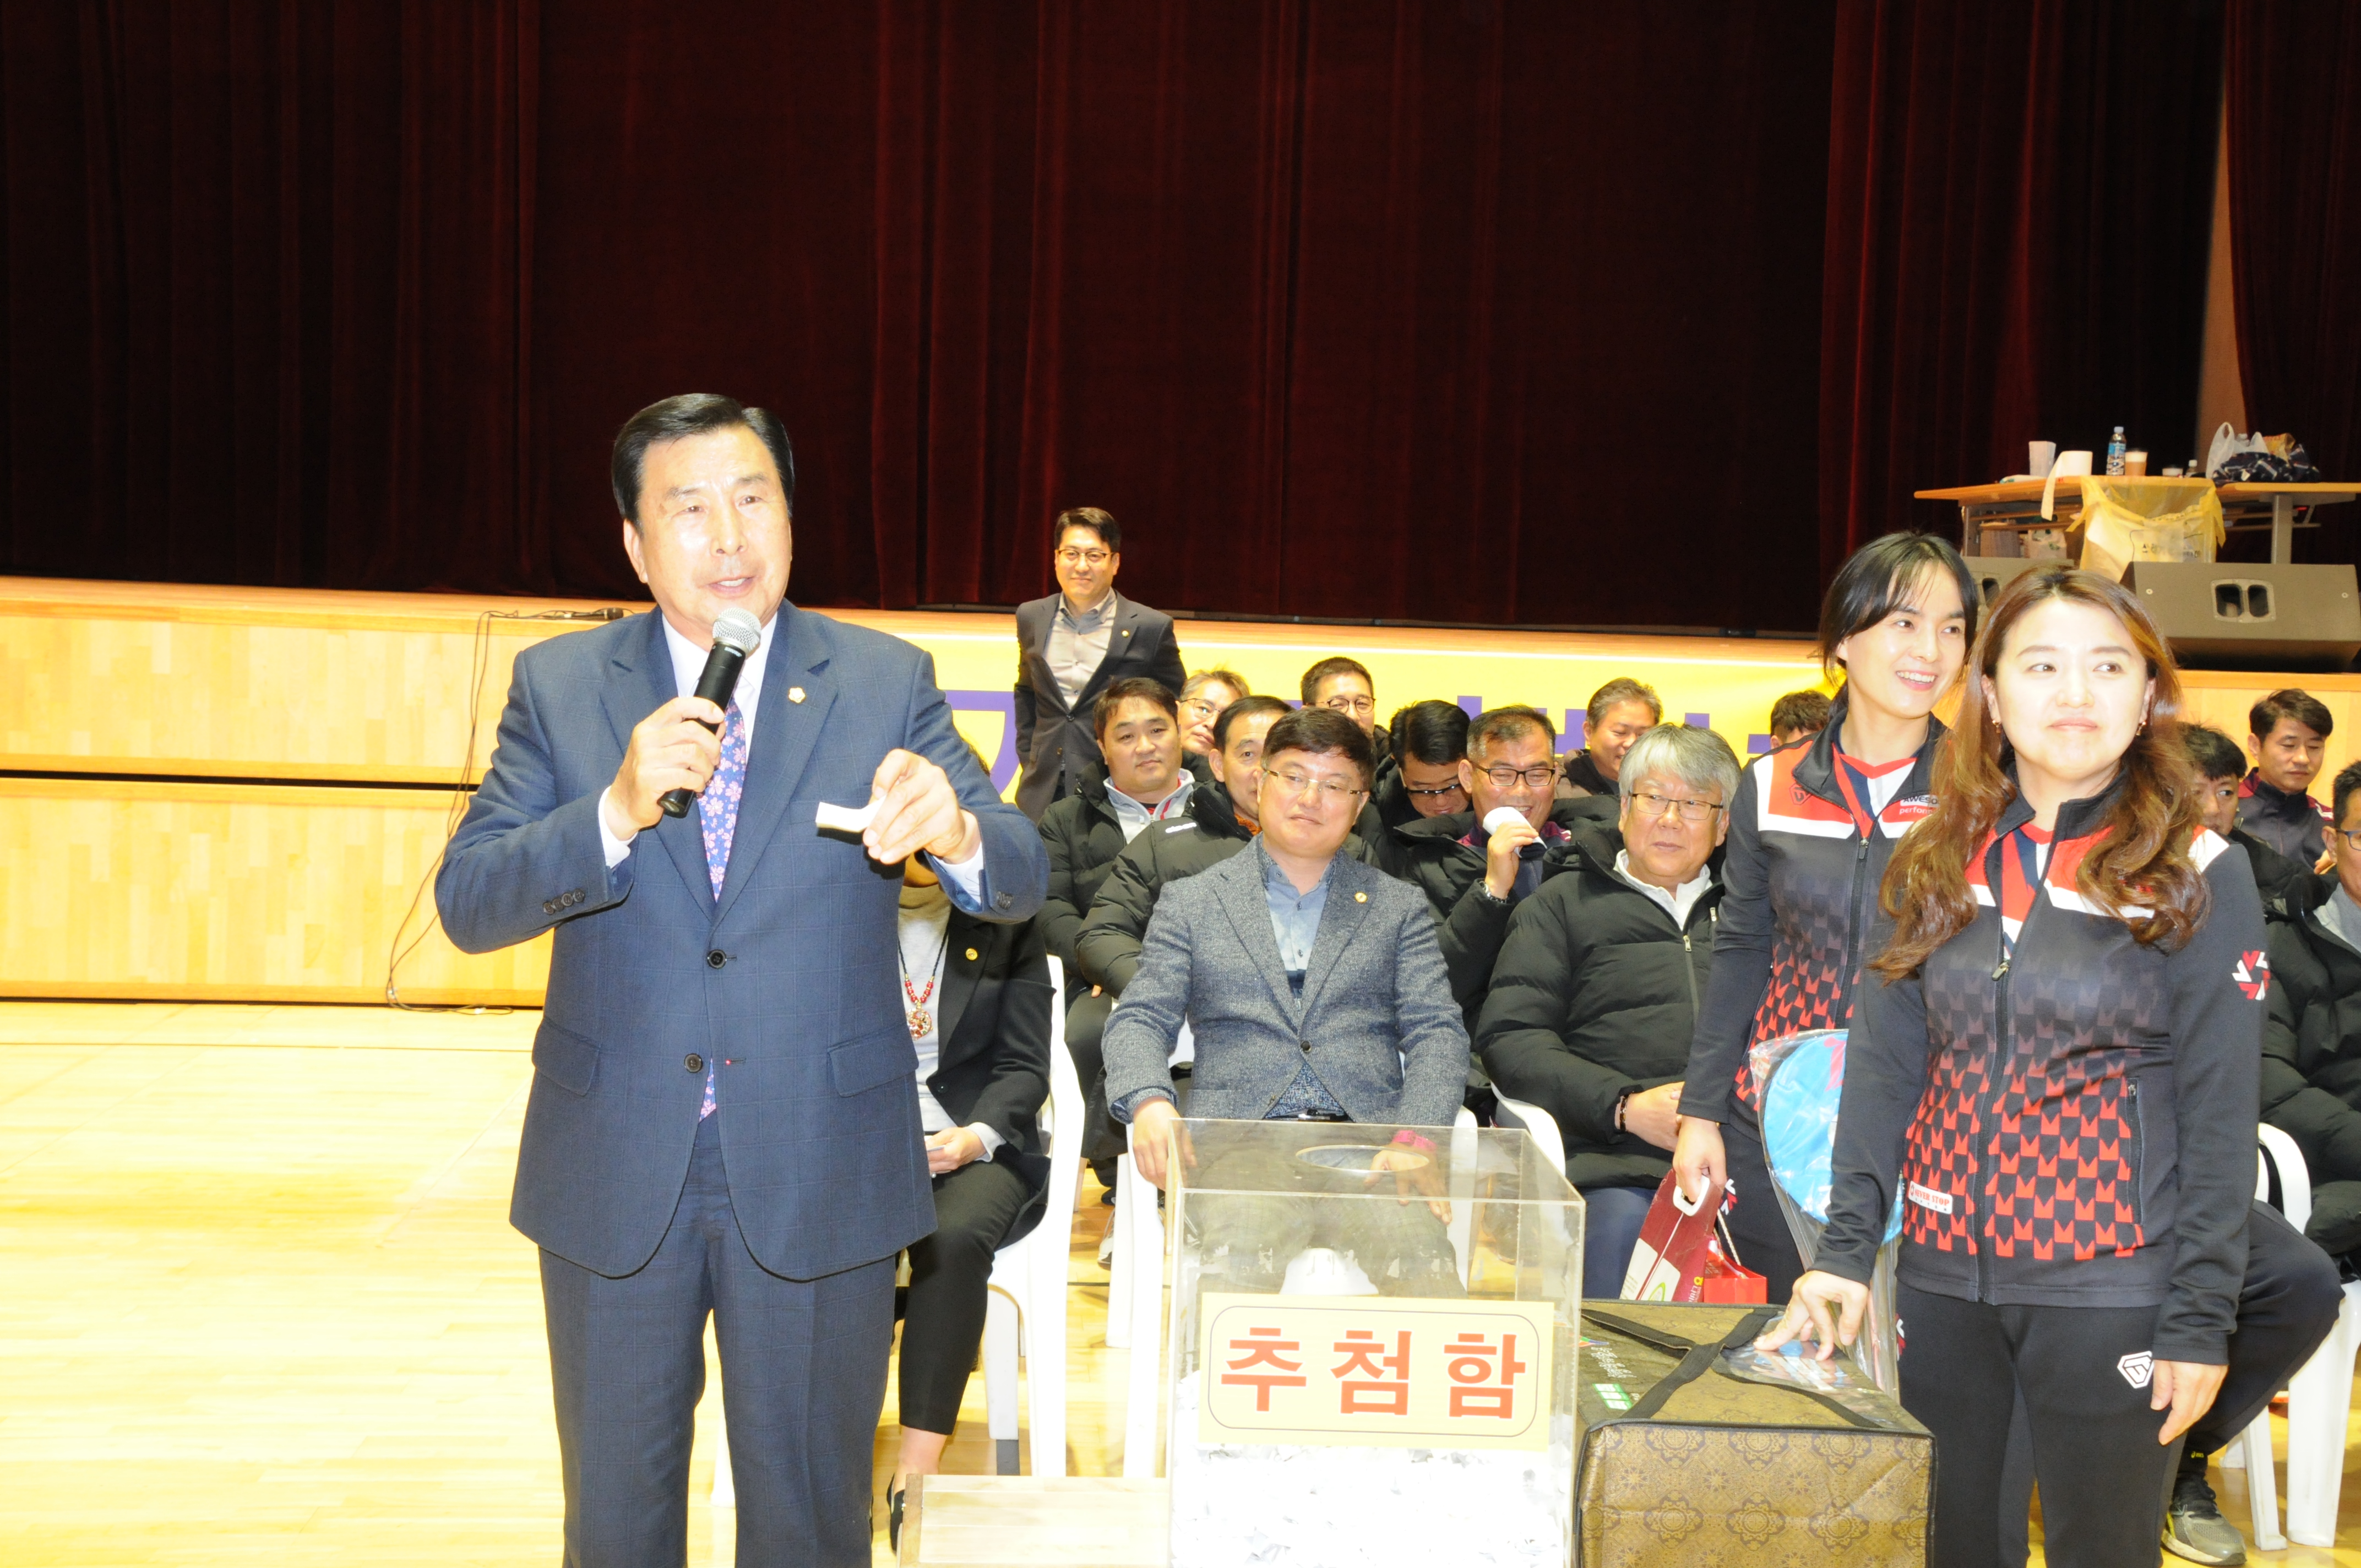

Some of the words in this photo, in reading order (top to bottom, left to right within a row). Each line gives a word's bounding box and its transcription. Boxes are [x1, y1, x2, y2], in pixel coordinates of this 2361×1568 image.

[1903, 796, 1938, 804] AWESO
[1914, 1189, 1930, 1201] NEVER
[1932, 1195, 1950, 1206] STOP
[1220, 1327, 1526, 1419] 추첨함
